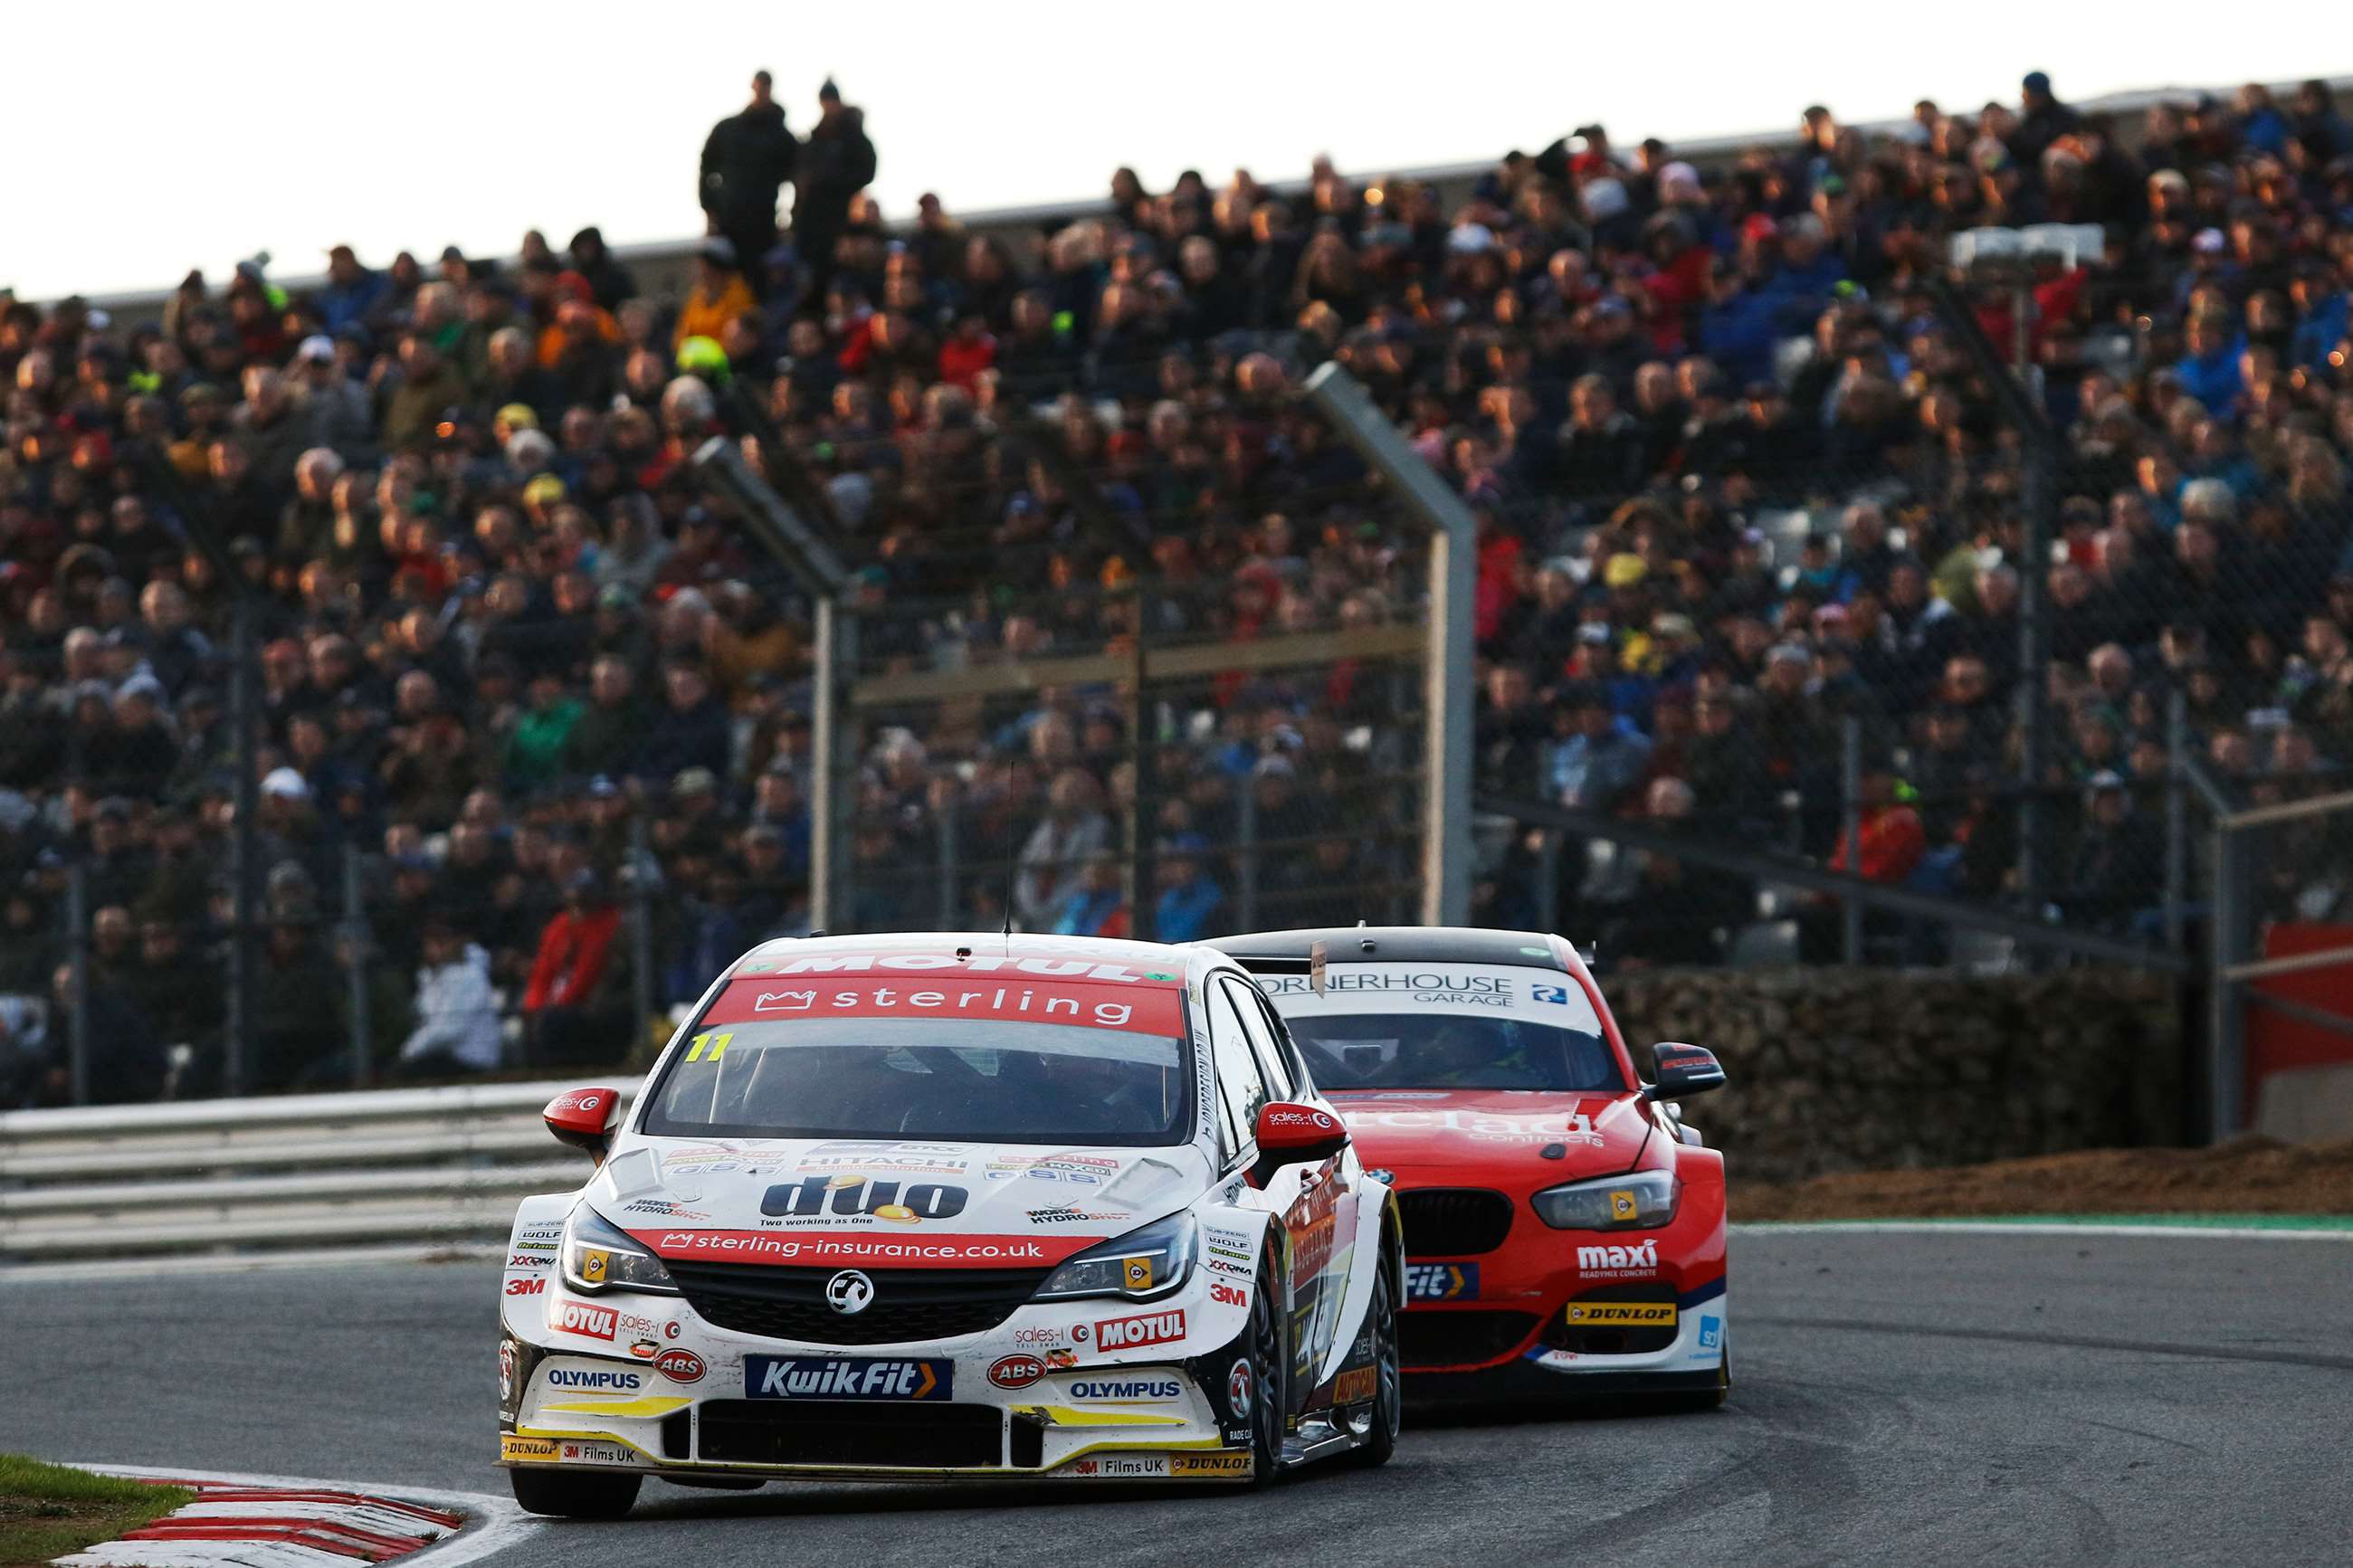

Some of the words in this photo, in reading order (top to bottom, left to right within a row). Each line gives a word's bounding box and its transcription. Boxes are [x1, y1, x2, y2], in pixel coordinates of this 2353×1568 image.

[776, 955, 1142, 983] MOTUL
[832, 988, 1132, 1025] sterling
[1414, 992, 1514, 1007] GARAGE
[685, 1033, 734, 1062] 11
[1469, 1131, 1605, 1147] contracts
[799, 1157, 969, 1169] HITACHI
[760, 1176, 969, 1219] duo
[786, 1218, 831, 1226] working
[695, 1234, 1043, 1259] sterling-insurance.co.uk
[1209, 1236, 1248, 1249] WOLF
[1577, 1239, 1658, 1269] maxi
[1619, 1269, 1657, 1278] CONCRETE
[506, 1278, 546, 1296] 3M
[1210, 1283, 1246, 1307] 3M
[1587, 1308, 1672, 1319] DUNLOP
[1101, 1312, 1185, 1347] MOTUL
[662, 1358, 699, 1374] ABS
[997, 1363, 1040, 1380] ABS
[548, 1369, 641, 1389] OLYMPUS
[1070, 1382, 1181, 1399] OLYMPUS
[510, 1441, 560, 1455] DUNLOP
[564, 1445, 579, 1458] 3M
[584, 1447, 614, 1461] Films
[617, 1449, 635, 1463] UK
[1075, 1460, 1098, 1475] 3M
[1105, 1459, 1141, 1474] Films
[1145, 1459, 1163, 1472] UK
